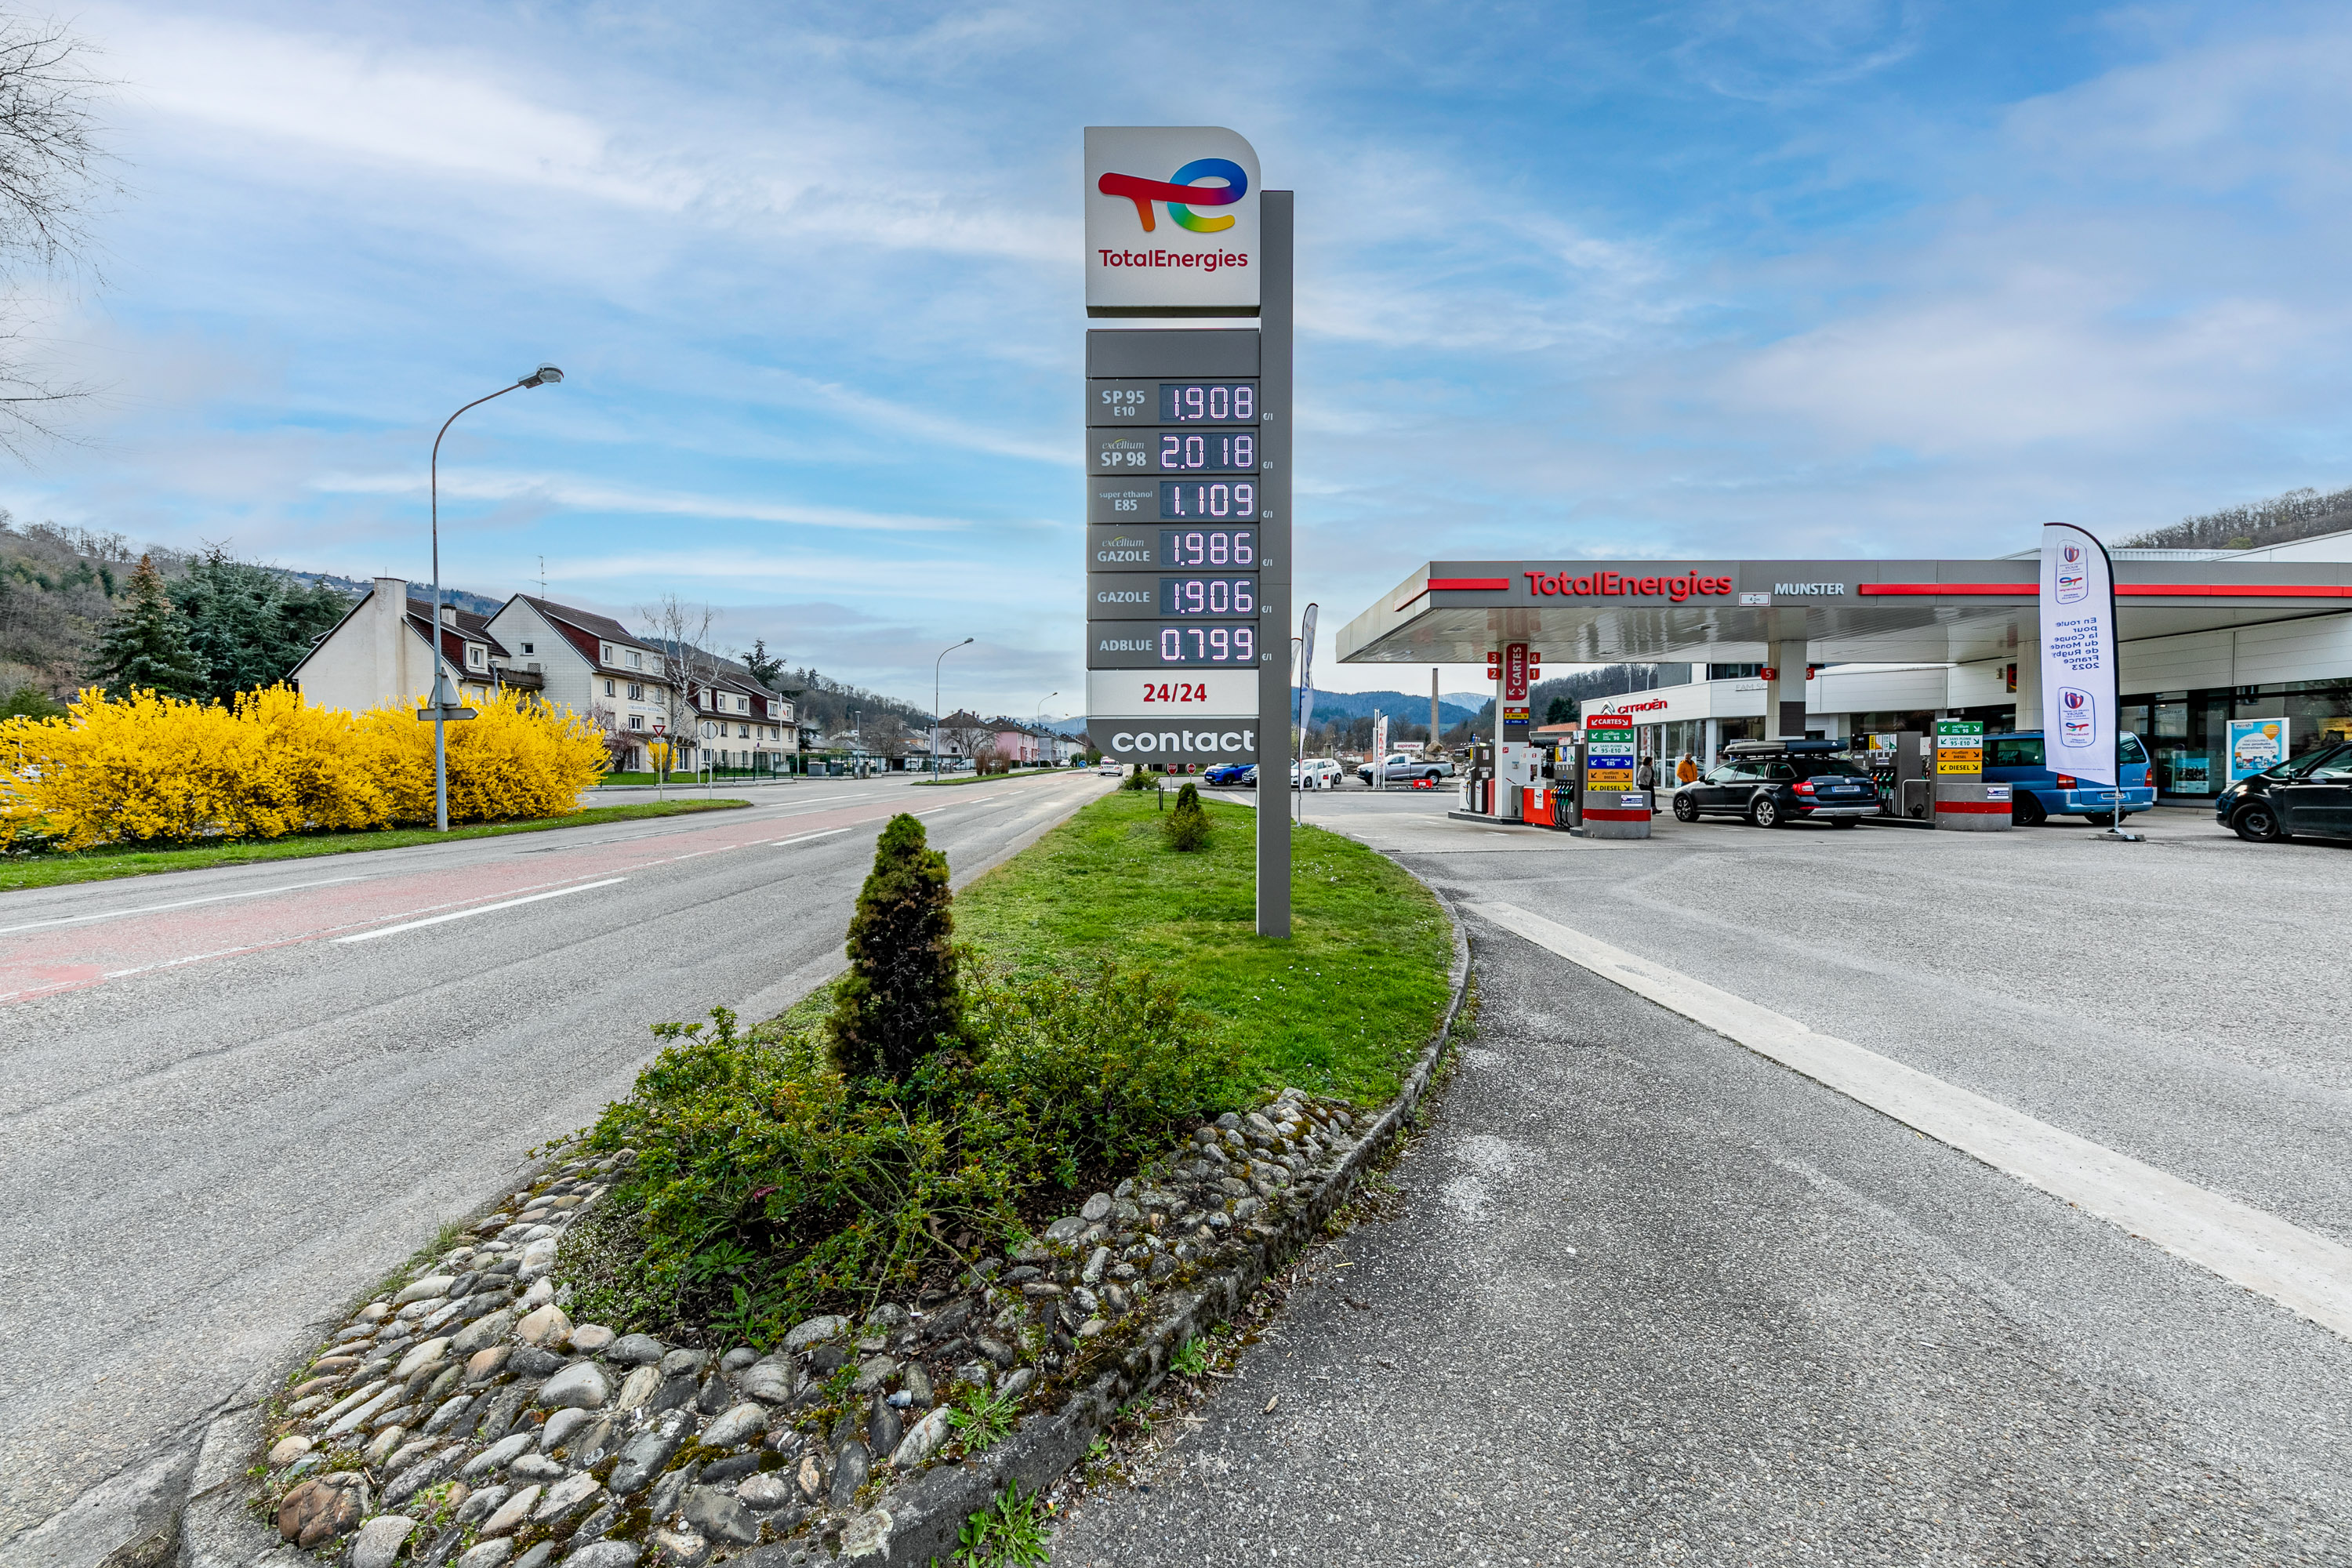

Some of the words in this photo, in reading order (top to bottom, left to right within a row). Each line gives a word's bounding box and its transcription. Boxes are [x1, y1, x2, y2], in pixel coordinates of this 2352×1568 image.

[1098, 249, 1248, 272] TotalEnergies
[1102, 390, 1123, 405] SP
[1126, 390, 1145, 405] 95
[1174, 387, 1253, 421] 1.908
[1114, 407, 1135, 417] E10
[1102, 439, 1145, 450] excellium
[1101, 452, 1123, 466] SP
[1126, 452, 1147, 466] 98
[1161, 435, 1253, 470] 2.018
[1115, 499, 1138, 511] E85
[1174, 484, 1253, 516] 1.109
[1102, 537, 1145, 547] excellium
[1174, 532, 1253, 566] 1.986
[1098, 550, 1150, 562] GAZOLE
[1524, 569, 1733, 602] TotalEnergies
[1773, 583, 1845, 596] MUNSTER
[1098, 591, 1150, 603] GAZOLE
[1174, 580, 1253, 614] 1.906
[1099, 640, 1152, 652] ADBLUE
[1161, 628, 1253, 660] 0.799
[1491, 653, 1497, 662] 3
[1530, 654, 1537, 662] 4
[1512, 647, 1521, 686] CARTES
[1490, 670, 1497, 678] 2
[1531, 670, 1536, 678] 1
[1766, 670, 1772, 678] 5
[1806, 670, 1812, 678] 6
[1143, 683, 1207, 702] 24/24
[1617, 699, 1668, 714] CITROËN
[1112, 730, 1254, 752] contact
